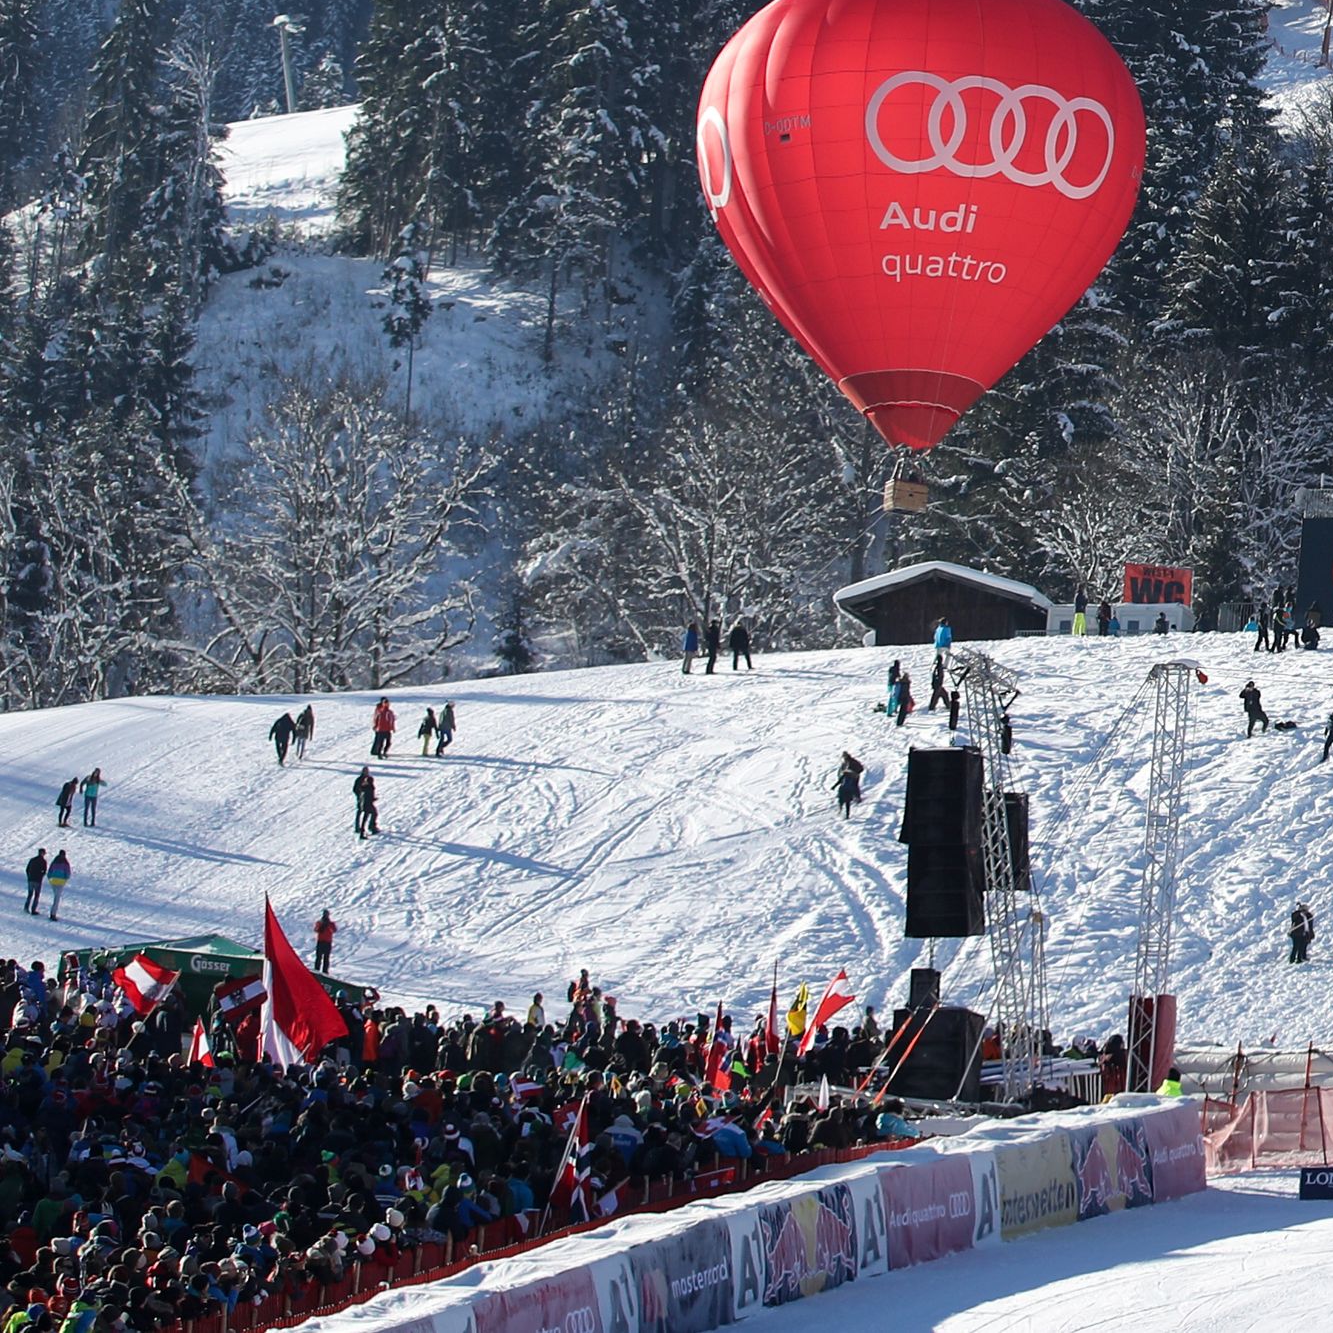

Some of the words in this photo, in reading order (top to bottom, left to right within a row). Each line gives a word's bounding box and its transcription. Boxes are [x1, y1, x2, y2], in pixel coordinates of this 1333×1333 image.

[879, 201, 978, 234] Audi
[881, 250, 1007, 284] quattro
[1130, 576, 1185, 604] WC
[912, 1204, 946, 1228] quattro
